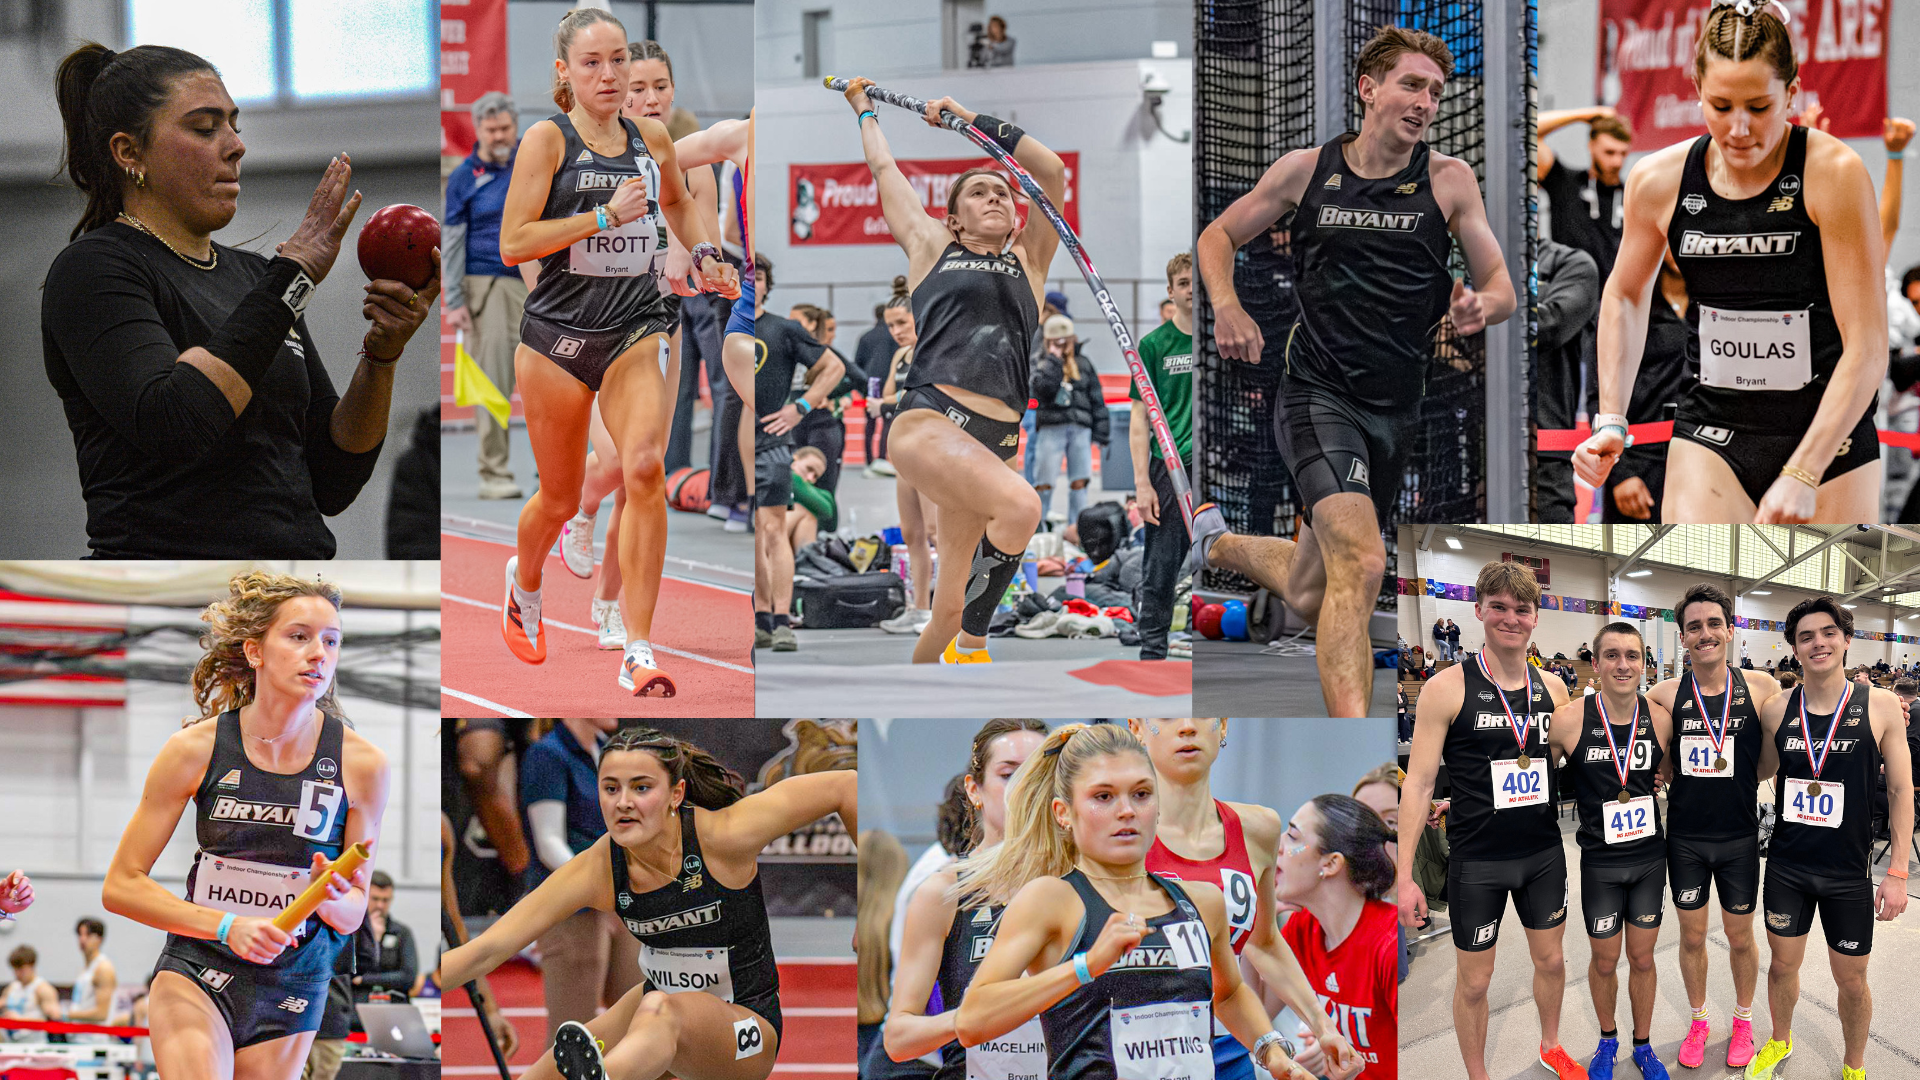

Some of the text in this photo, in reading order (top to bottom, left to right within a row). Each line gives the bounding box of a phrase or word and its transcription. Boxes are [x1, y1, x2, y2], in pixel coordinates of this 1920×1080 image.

[645, 159, 657, 199] 1
[1320, 207, 1415, 229] BRYANT
[585, 236, 649, 253] TROTT
[1682, 233, 1793, 255] BRYANT
[605, 265, 629, 274] Bryant
[942, 261, 1018, 276] BRYANT
[1710, 339, 1796, 359] GOULAS
[1736, 376, 1766, 386] Bryant
[1634, 741, 1647, 769] 9
[318, 763, 335, 773] LLJR
[1502, 771, 1541, 795] 402
[212, 798, 300, 824] BRYAN
[304, 785, 335, 836] 5
[1793, 791, 1833, 816] 410
[1611, 807, 1647, 831] 412
[246, 868, 288, 878] Championship
[1230, 873, 1251, 925] 9
[627, 905, 716, 934] BRYANT
[1176, 924, 1209, 964] 11
[647, 968, 719, 989] WILSON
[1134, 1013, 1154, 1021] Indoor
[737, 1025, 761, 1052] 8
[1124, 1036, 1204, 1060] WHITING
